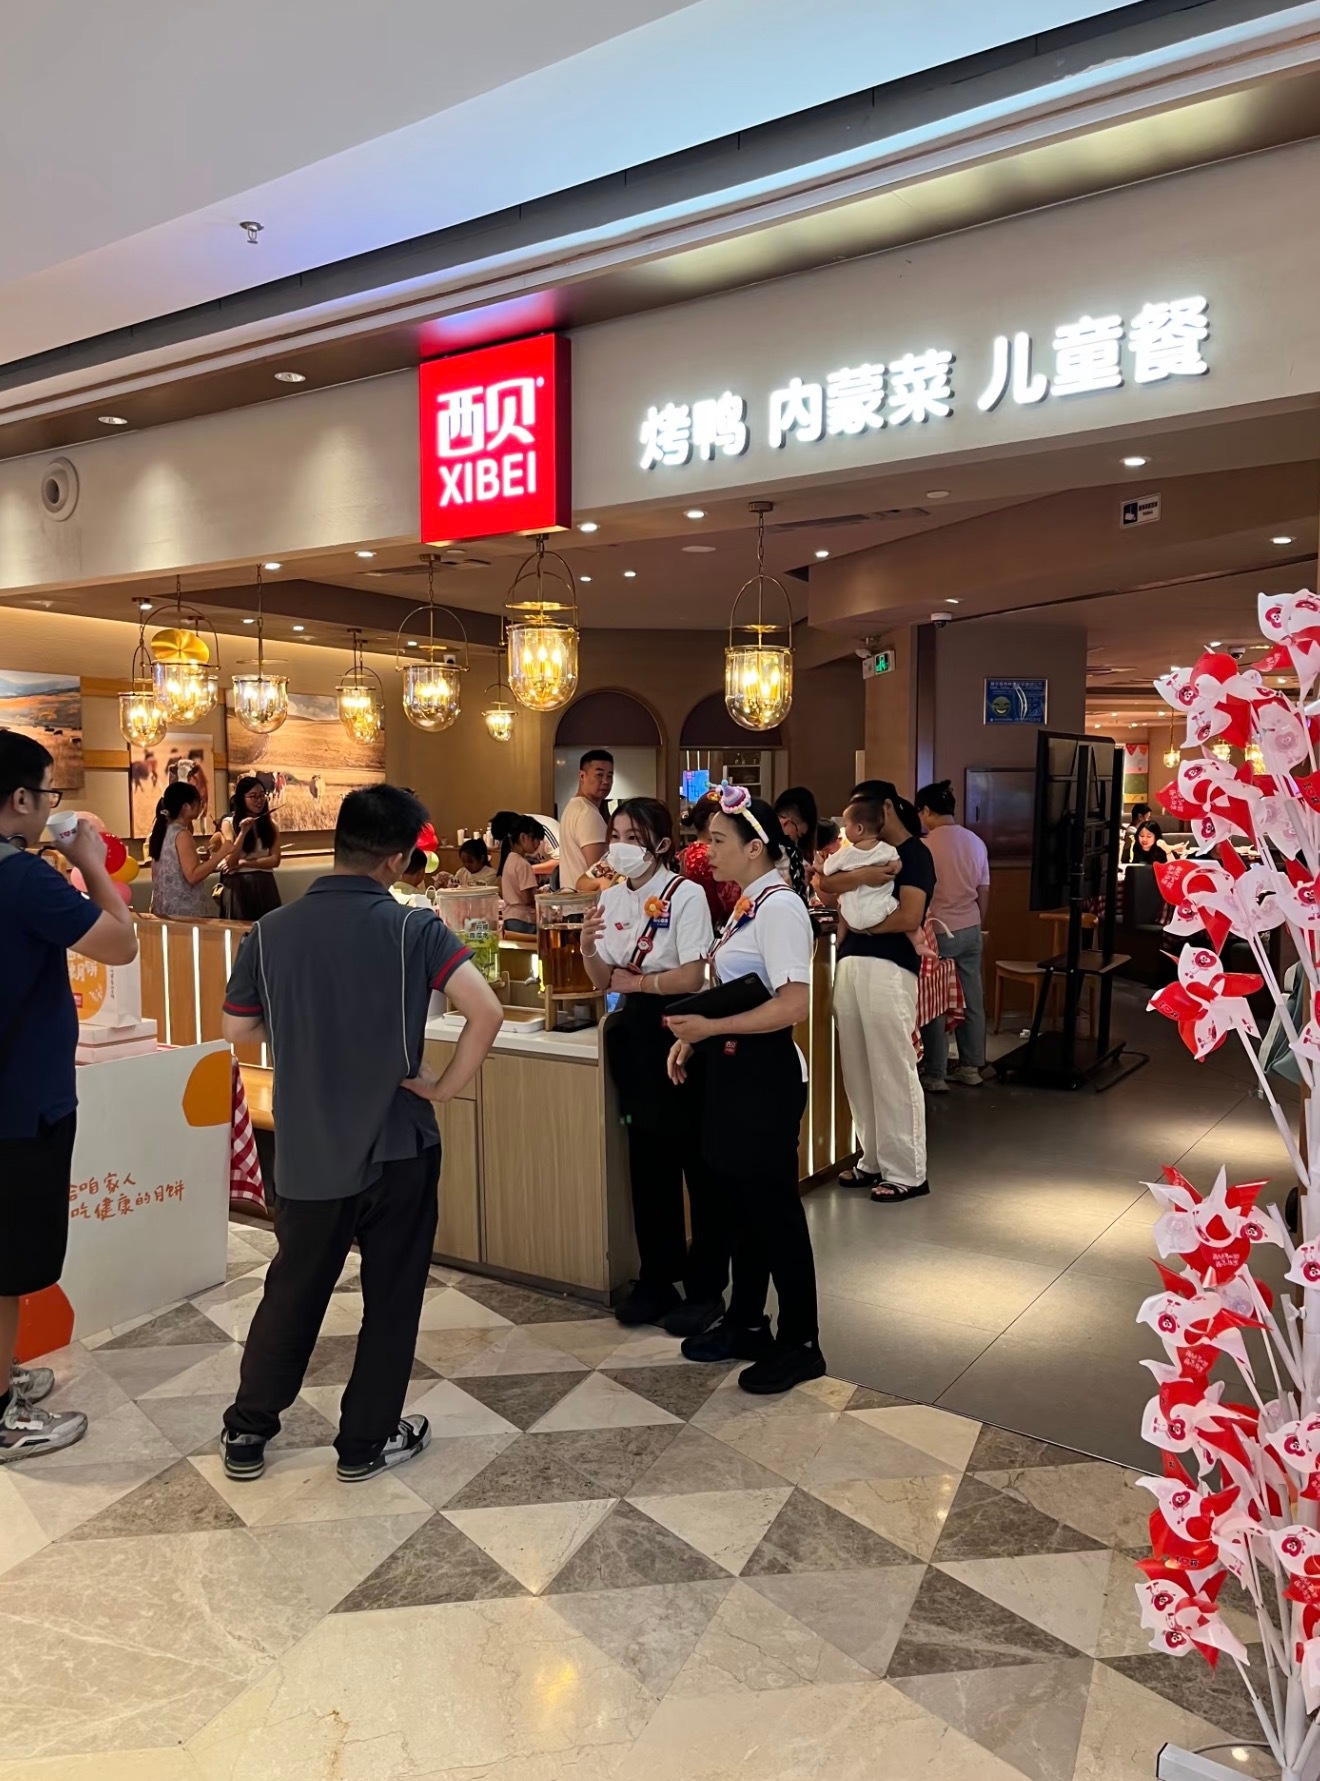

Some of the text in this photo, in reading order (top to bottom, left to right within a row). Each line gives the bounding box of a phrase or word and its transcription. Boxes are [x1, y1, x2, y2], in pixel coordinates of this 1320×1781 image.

[436, 376, 537, 459] 西贝
[639, 294, 1209, 470] 烤鸭 内蒙菜 儿童餐
[438, 450, 537, 508] XIBEI
